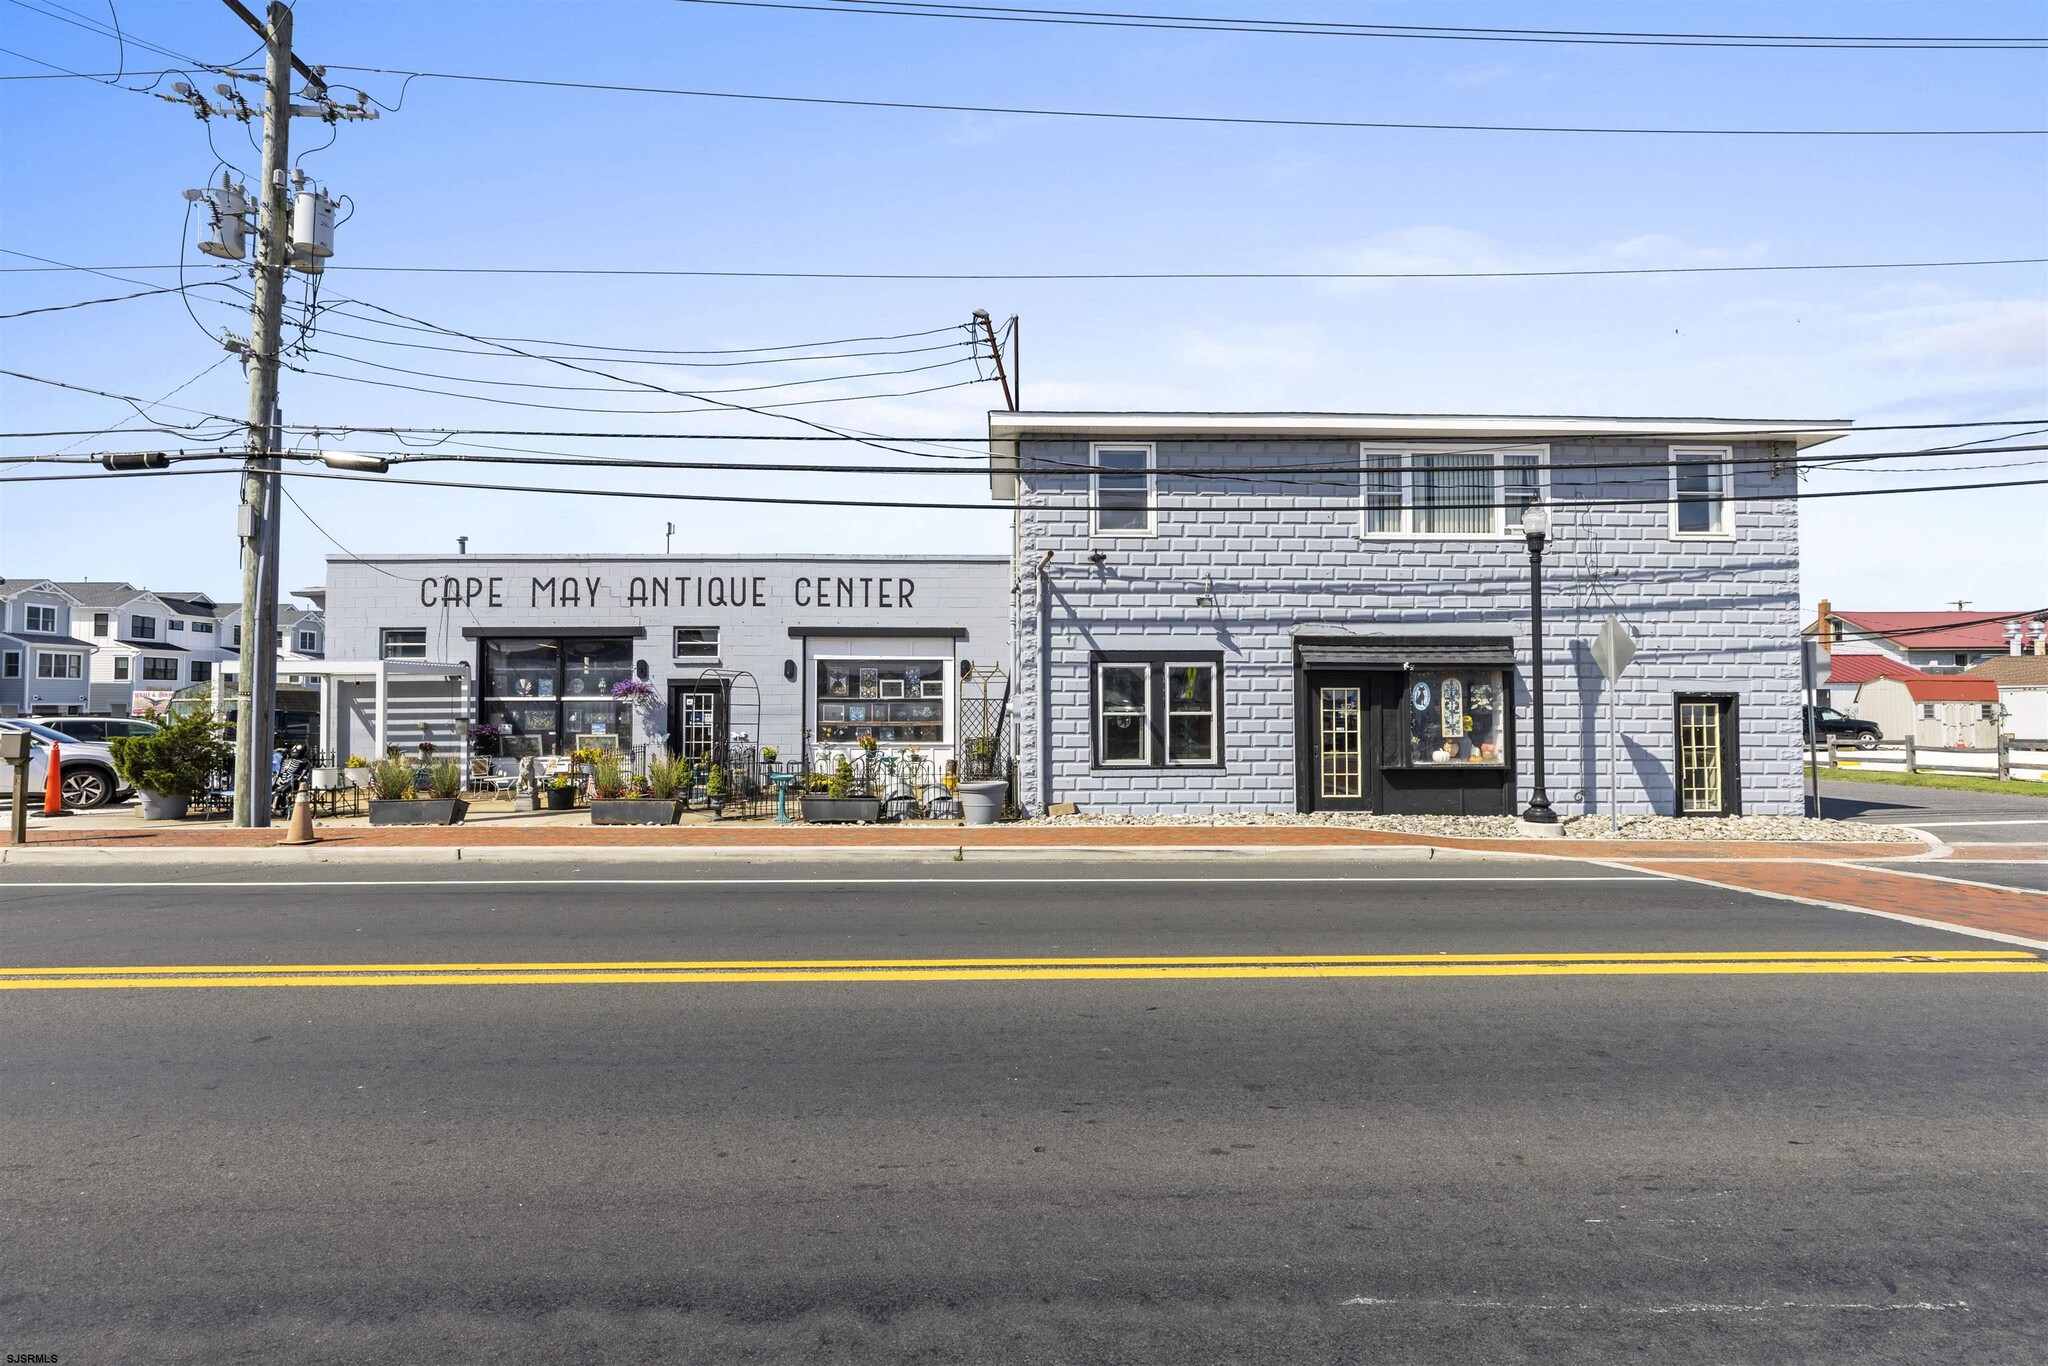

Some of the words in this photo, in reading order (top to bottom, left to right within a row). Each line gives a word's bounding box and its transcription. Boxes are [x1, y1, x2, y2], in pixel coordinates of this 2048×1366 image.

[421, 577, 503, 608] CAPE
[531, 577, 599, 608] MAY
[628, 576, 766, 607] ANTIQUE
[795, 577, 915, 608] CENTER
